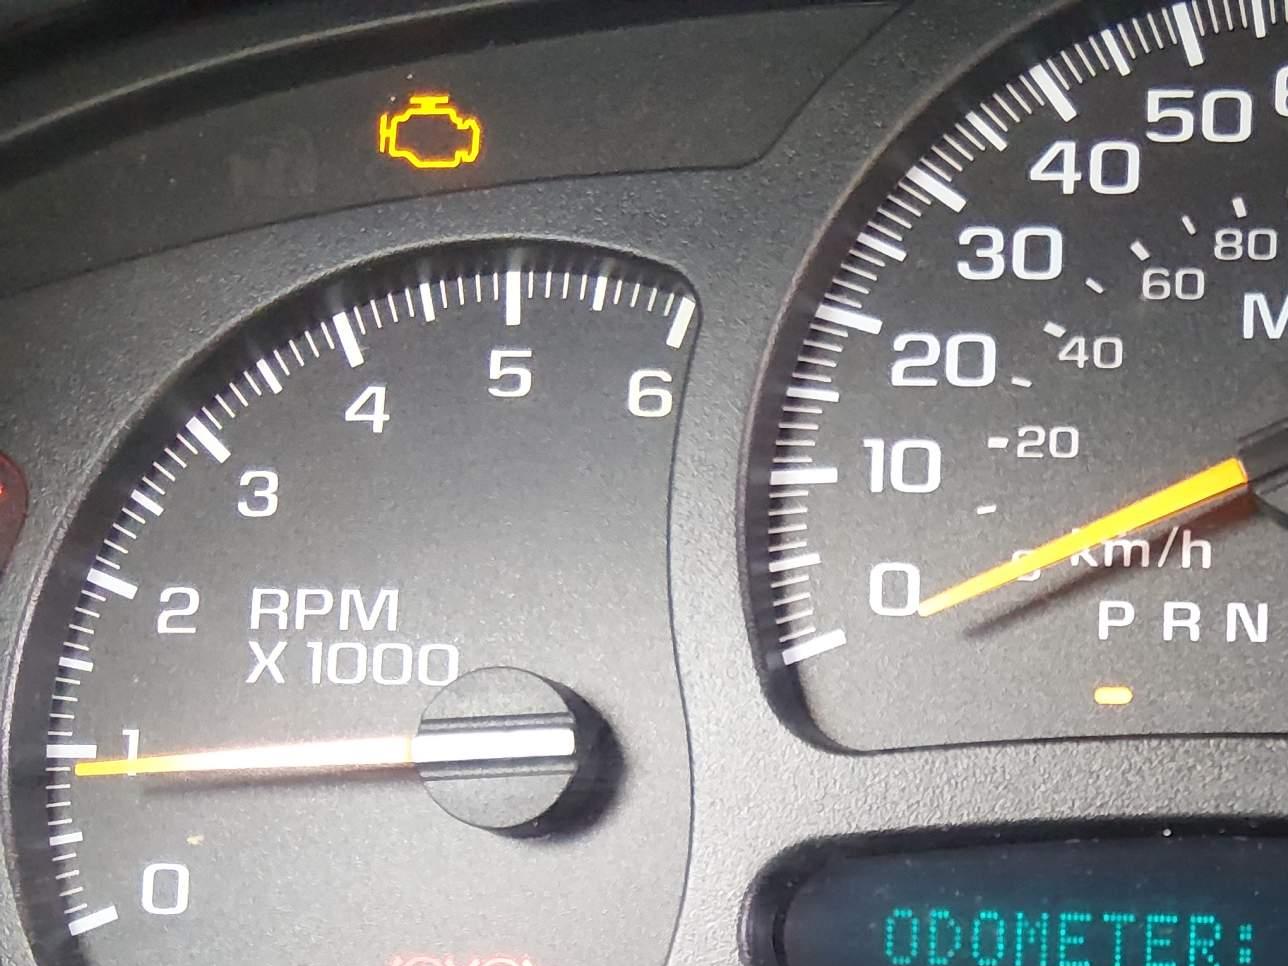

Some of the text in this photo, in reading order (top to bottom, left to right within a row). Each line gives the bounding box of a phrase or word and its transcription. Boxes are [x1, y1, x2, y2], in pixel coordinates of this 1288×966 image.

[1145, 88, 1253, 143] 50
[1029, 140, 1141, 195] 40
[956, 226, 1063, 282] 30
[1213, 228, 1278, 261] 80
[1141, 268, 1206, 301] 60
[488, 349, 534, 398] 5
[890, 332, 997, 388] 20
[1057, 336, 1124, 369] 40
[344, 385, 390, 434] 4
[626, 369, 674, 418] 6
[862, 438, 942, 494] 10
[1015, 425, 1080, 459] 20
[237, 470, 281, 518] 3
[156, 586, 200, 634] 2
[249, 588, 399, 631] RPM
[868, 562, 921, 617] 0
[1099, 601, 1135, 642] P
[1162, 602, 1202, 643] R
[1225, 602, 1268, 643] N
[246, 643, 459, 687] X 1000
[121, 729, 140, 776] 1
[141, 862, 190, 915] 0
